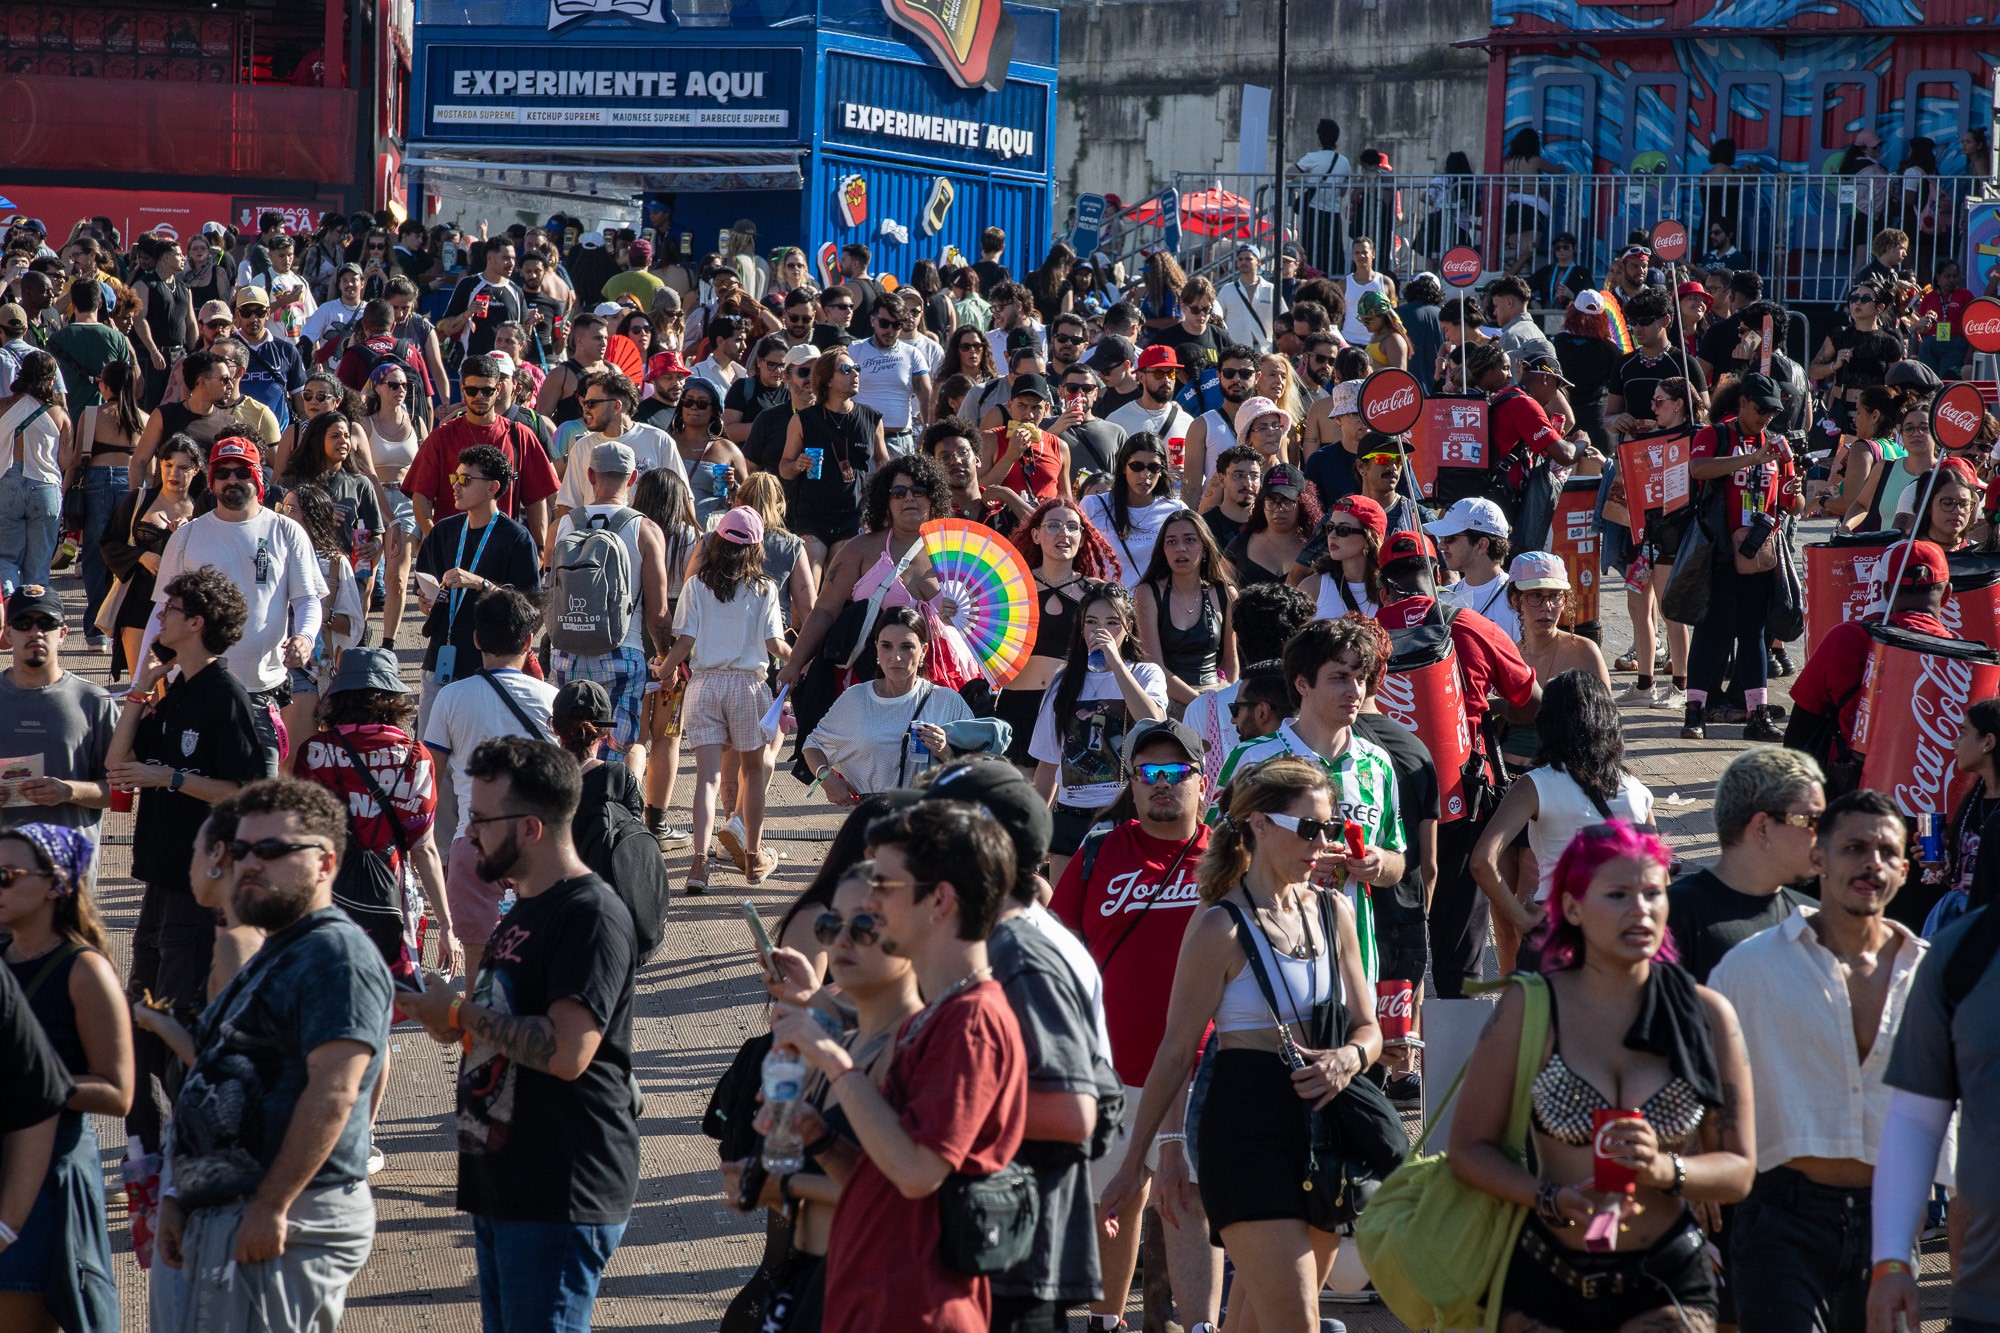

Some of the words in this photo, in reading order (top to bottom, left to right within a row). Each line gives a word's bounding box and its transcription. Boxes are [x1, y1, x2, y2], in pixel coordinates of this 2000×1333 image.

[453, 70, 676, 97] EXPERIMENTE
[684, 71, 764, 103] AQUI
[437, 110, 477, 119] MOSTARDA
[480, 111, 515, 120] SUPREME
[527, 111, 562, 121] KETCHUP
[564, 112, 600, 121] SUPREME
[612, 112, 651, 122] MAIONESE
[654, 113, 690, 122] SUPREME
[701, 114, 741, 123] BARBECUE
[743, 114, 780, 123] SUPREME
[845, 103, 980, 147] EXPERIMENTE
[985, 124, 1034, 159] AQUI
[863, 355, 903, 368] Brazilian
[870, 362, 896, 374] Lover
[1366, 385, 1415, 420] Coca-Cola
[1460, 413, 1480, 428] 12
[1938, 401, 1981, 432] Coca-Cola
[1447, 442, 1463, 460] 8
[1649, 475, 1663, 483] CRY
[557, 615, 582, 623] ISTRIA
[584, 614, 601, 623] 100
[1894, 653, 1973, 818] Coca-Cola
[1449, 800, 1461, 810] 09
[1341, 803, 1379, 827] REE
[1101, 869, 1200, 917] Jorda
